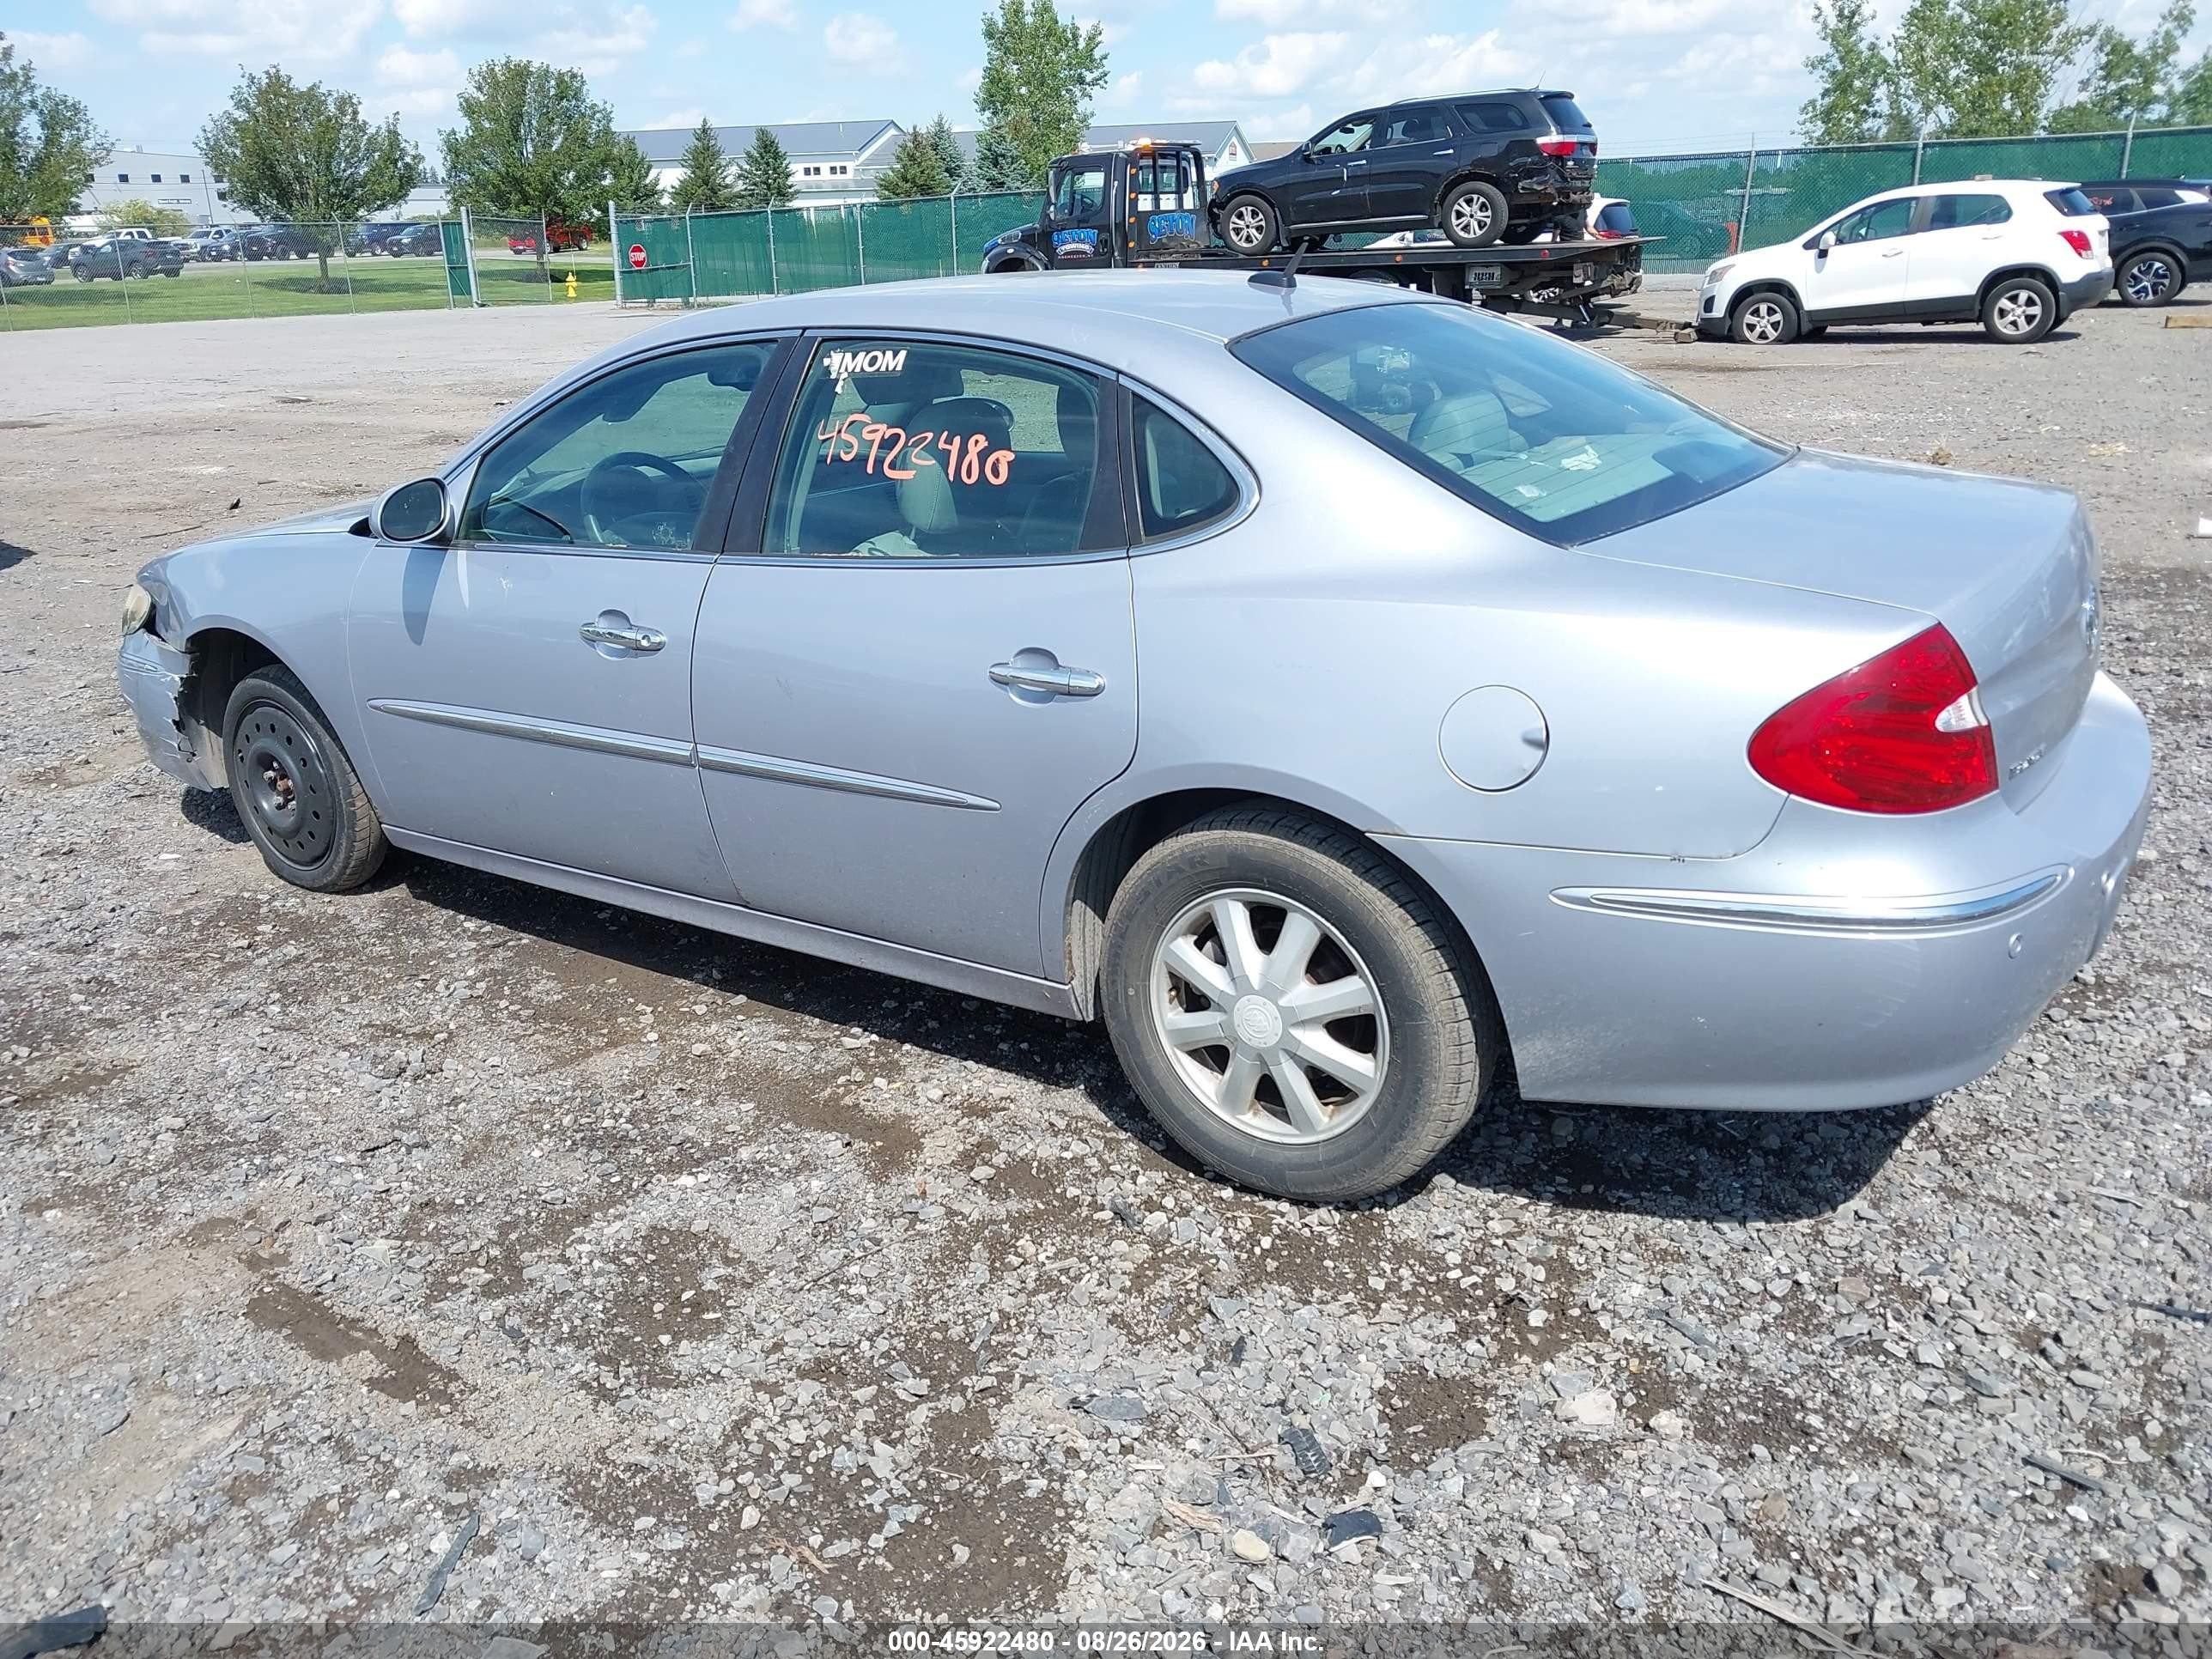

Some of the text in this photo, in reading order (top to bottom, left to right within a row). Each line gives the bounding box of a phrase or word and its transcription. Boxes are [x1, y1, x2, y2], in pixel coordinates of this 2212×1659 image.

[1052, 228, 1097, 247] SETON
[1148, 213, 1196, 244] SETON
[631, 252, 645, 262] STOP
[1059, 243, 1092, 253] TOWING
[817, 413, 1016, 485] 45922480
